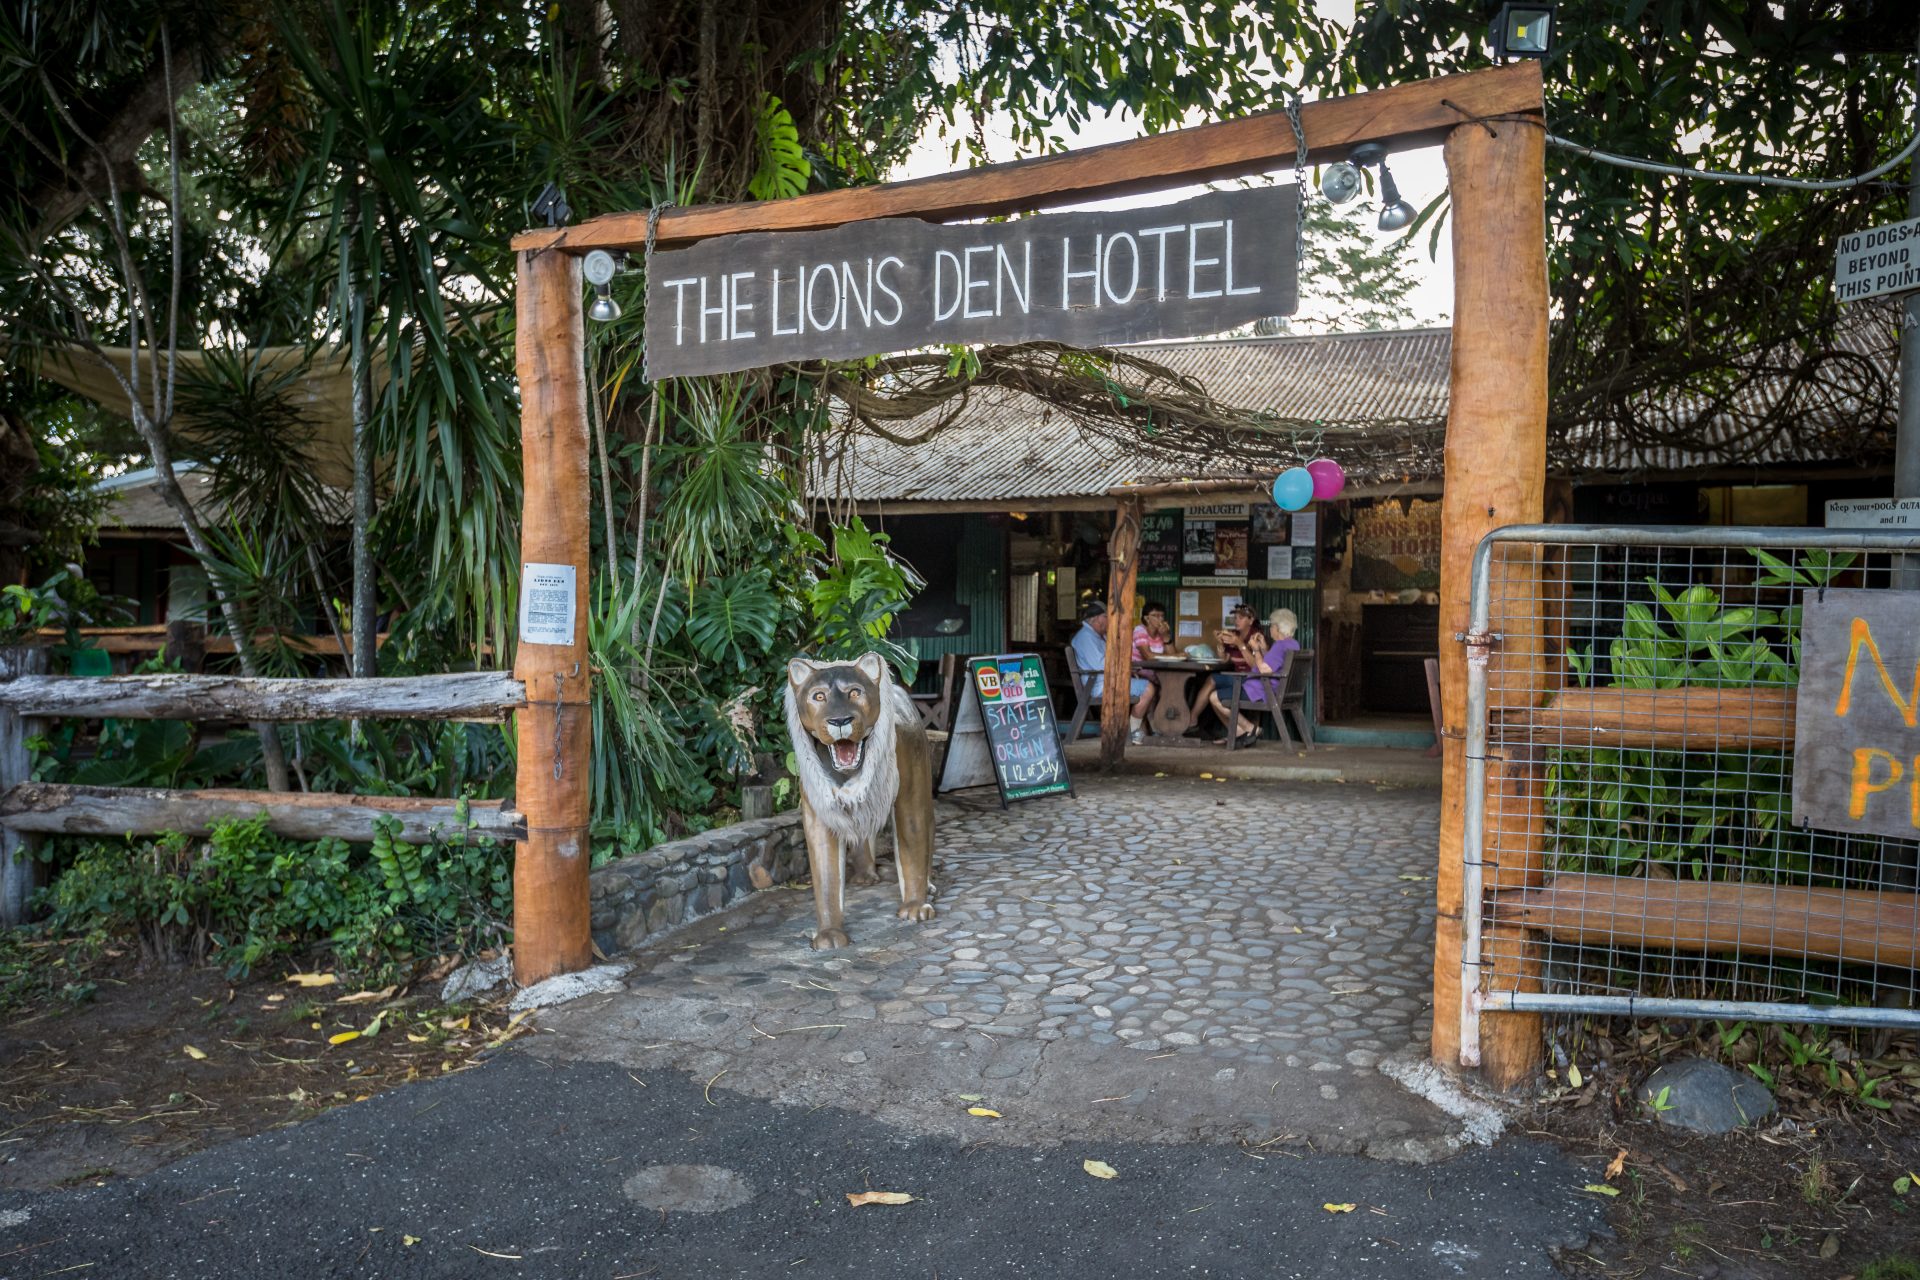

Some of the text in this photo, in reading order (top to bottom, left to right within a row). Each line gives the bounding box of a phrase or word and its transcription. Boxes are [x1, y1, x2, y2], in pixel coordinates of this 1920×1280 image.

[1840, 236, 1860, 255] NO
[1866, 225, 1908, 249] DOGS
[1848, 247, 1910, 275] BEYOND
[663, 219, 1261, 346] THE LIONS DEN HOTEL
[1838, 266, 1920, 298] THIS POINT
[1189, 504, 1245, 515] DRAUGHT
[1830, 503, 1849, 513] Keep
[1853, 503, 1870, 513] your
[1875, 502, 1897, 511] DOGS
[1880, 515, 1908, 524] and I'll
[980, 676, 998, 687] VB
[1003, 685, 1023, 698] QLD
[1010, 724, 1028, 741] OF
[996, 737, 1045, 762] ORIGIN
[1012, 764, 1027, 782] 12
[1036, 756, 1059, 782] July
